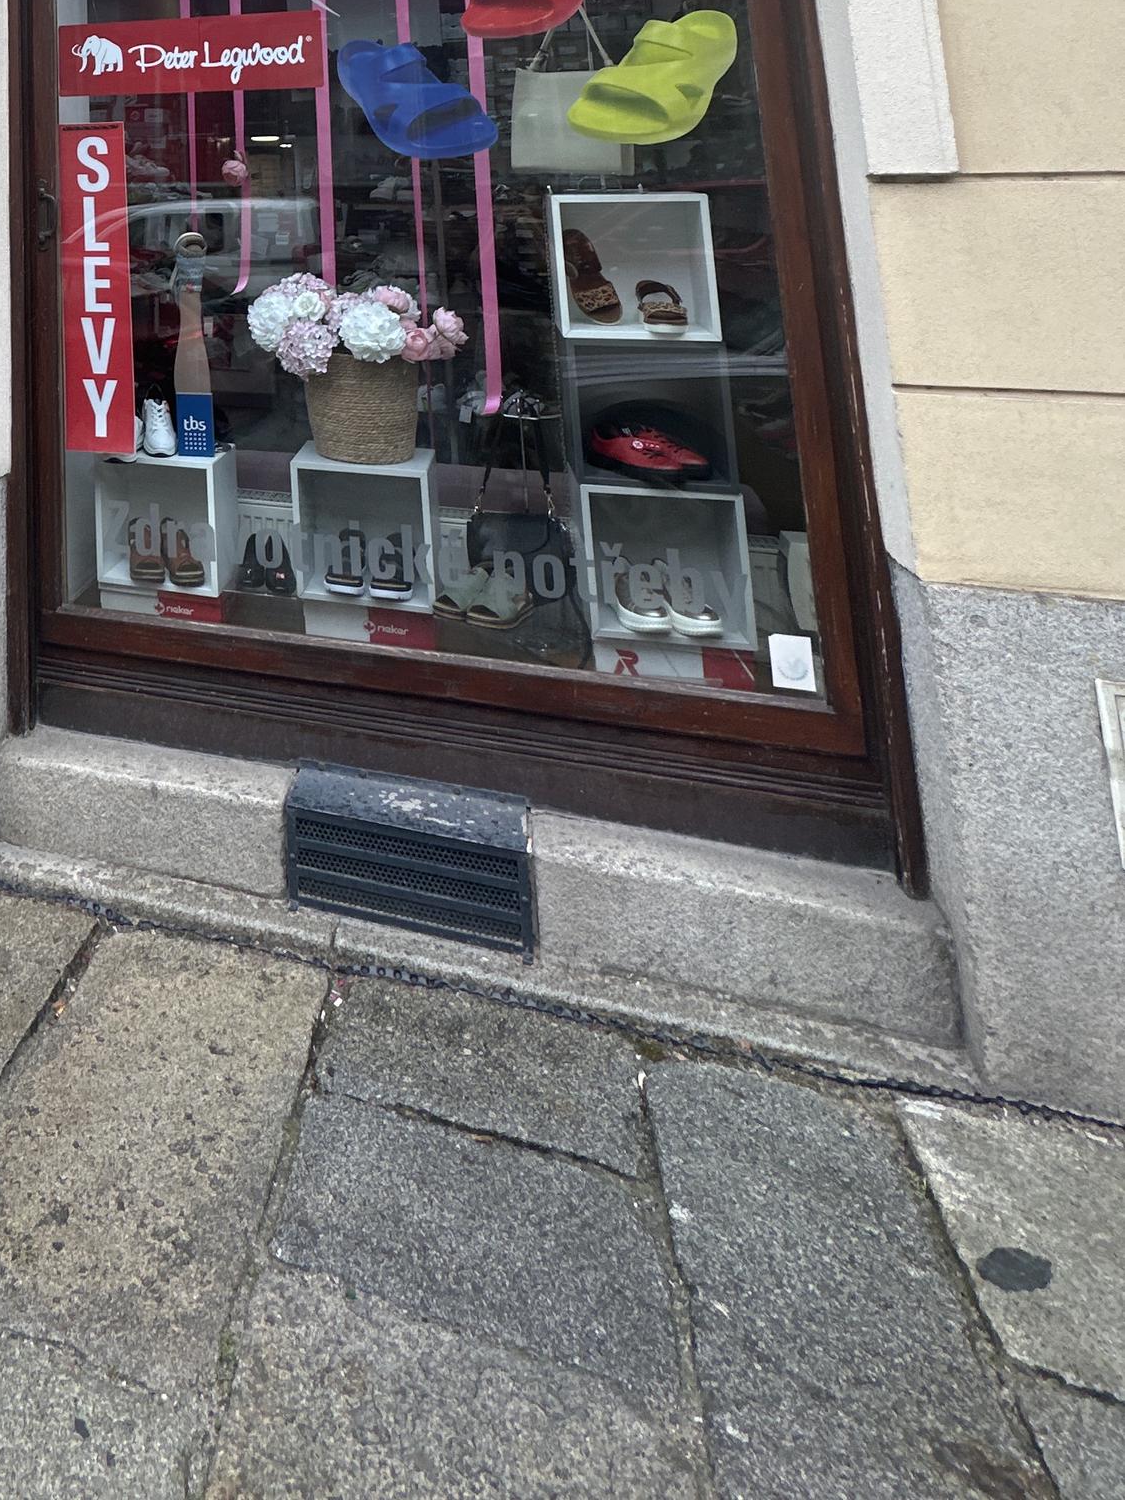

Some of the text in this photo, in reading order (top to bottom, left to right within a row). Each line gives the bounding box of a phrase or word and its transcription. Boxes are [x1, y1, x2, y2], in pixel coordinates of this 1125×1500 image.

[127, 35, 305, 84] Peter Legwood
[76, 136, 118, 438] SLEVY
[183, 415, 207, 431] tbs
[105, 500, 749, 623] Zdravotnické potřeby
